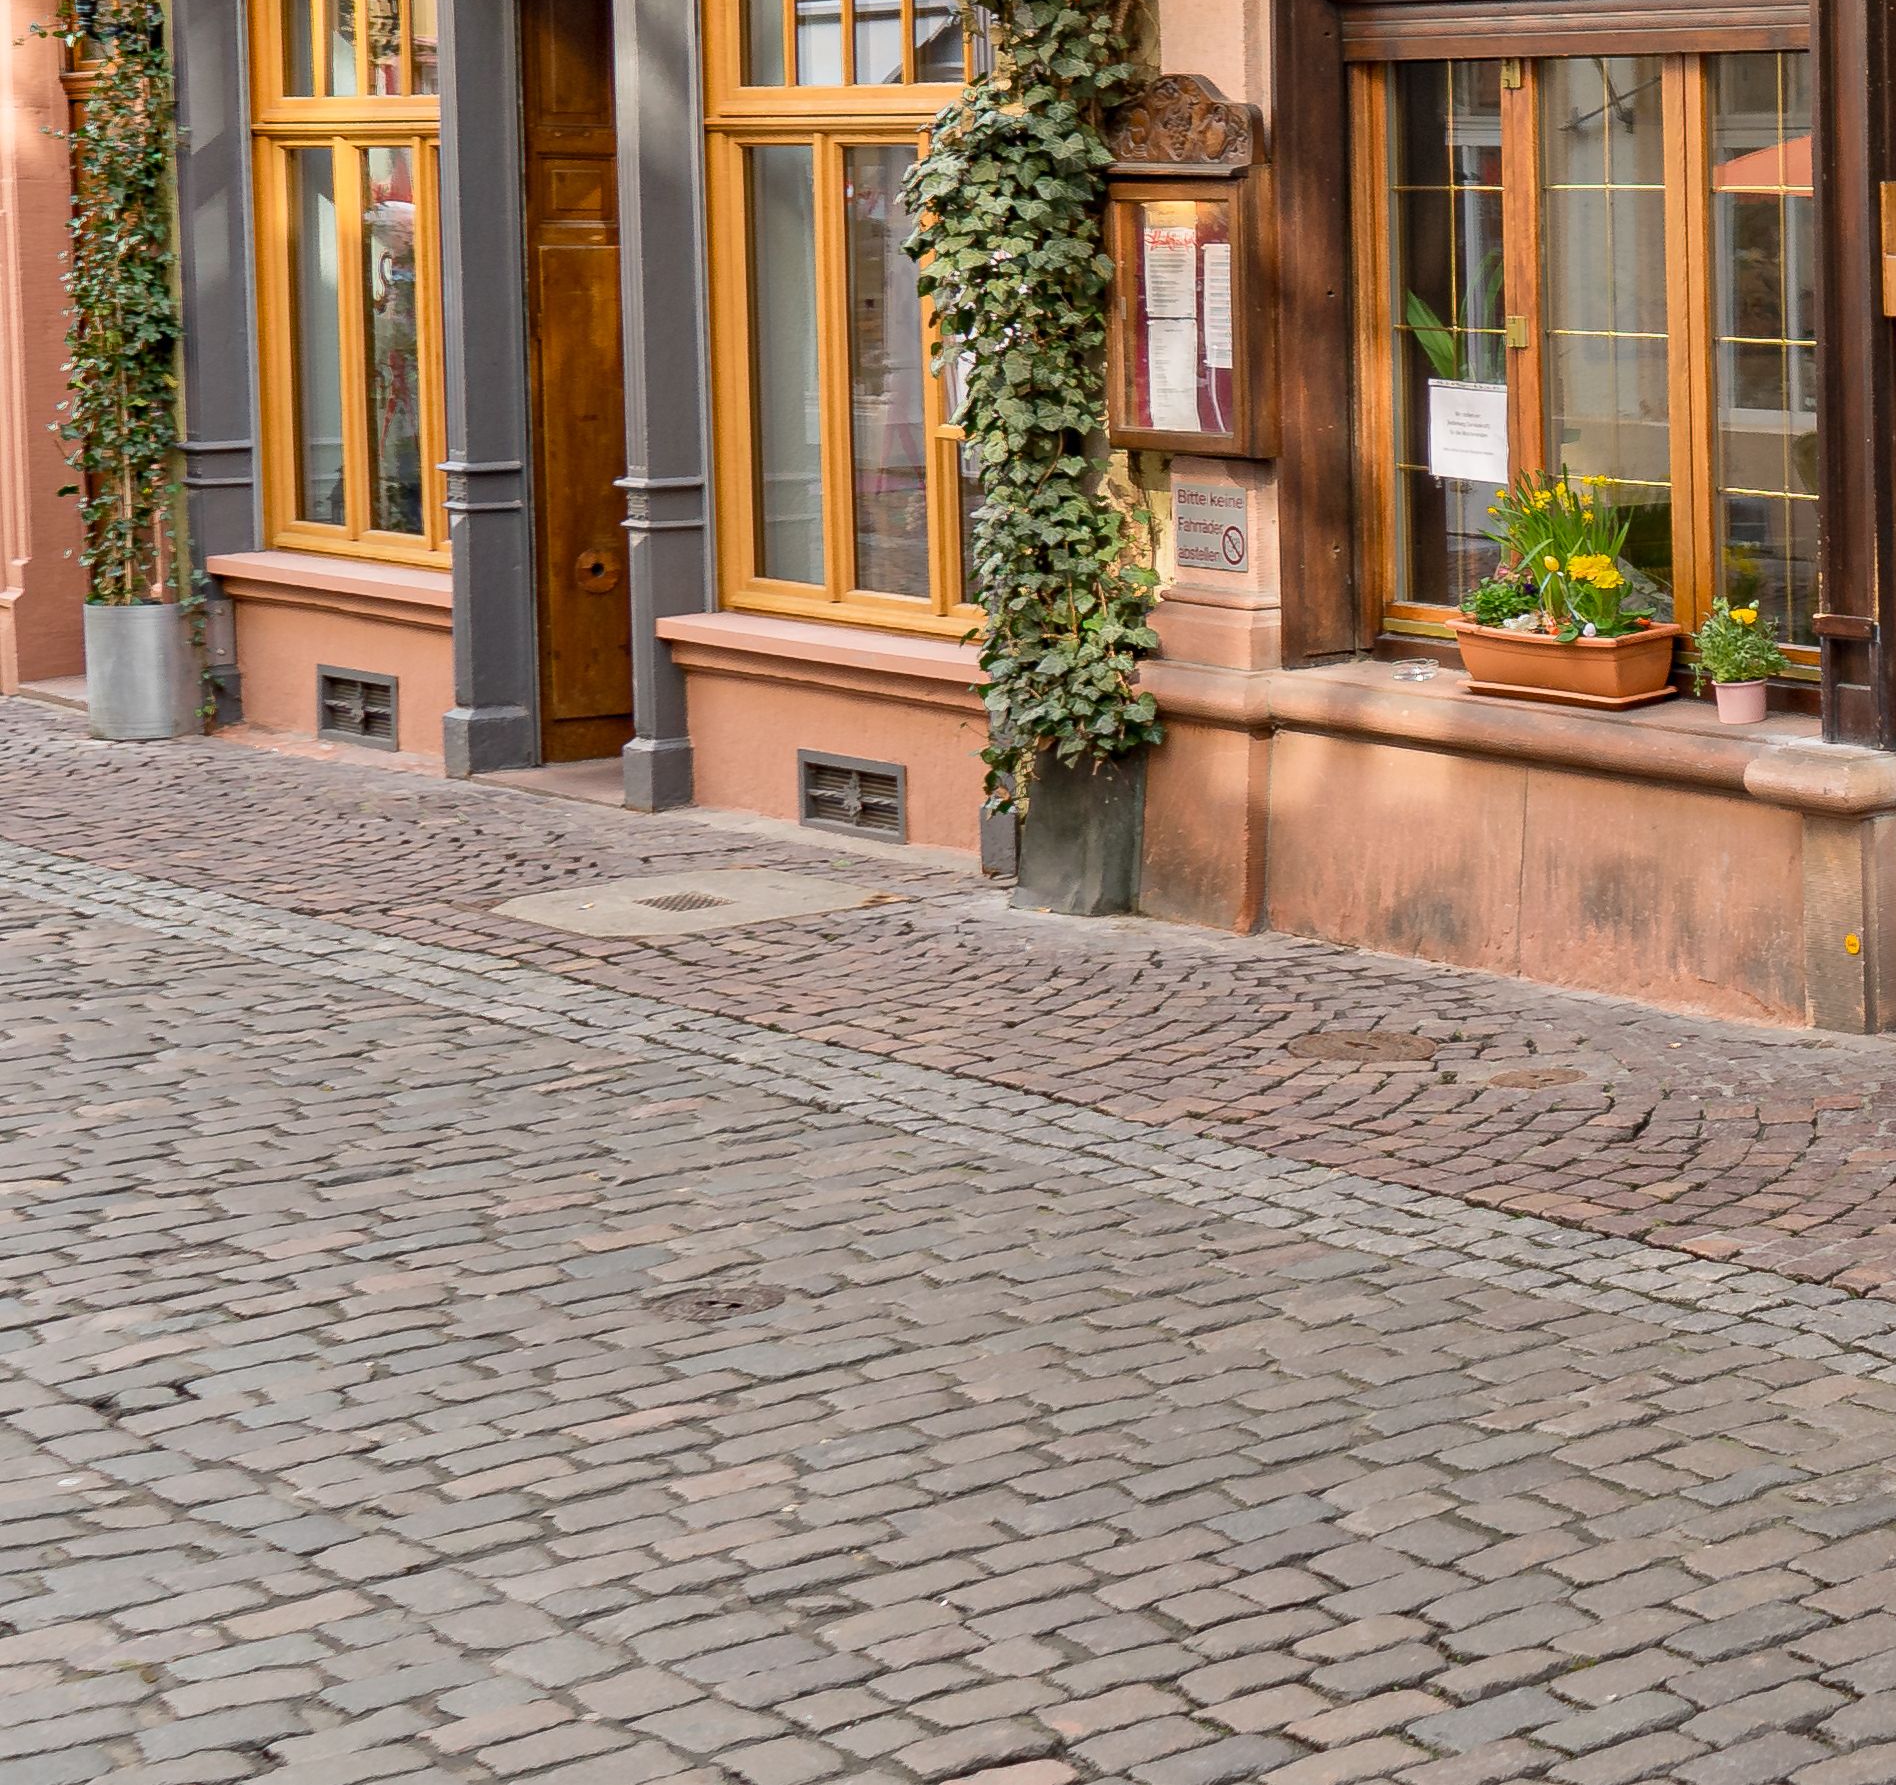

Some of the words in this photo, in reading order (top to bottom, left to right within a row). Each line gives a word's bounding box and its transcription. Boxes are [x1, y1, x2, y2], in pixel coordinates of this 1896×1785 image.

[1177, 488, 1206, 505] Bitte
[1209, 492, 1243, 509] keine
[1178, 516, 1223, 535] Fahrräder
